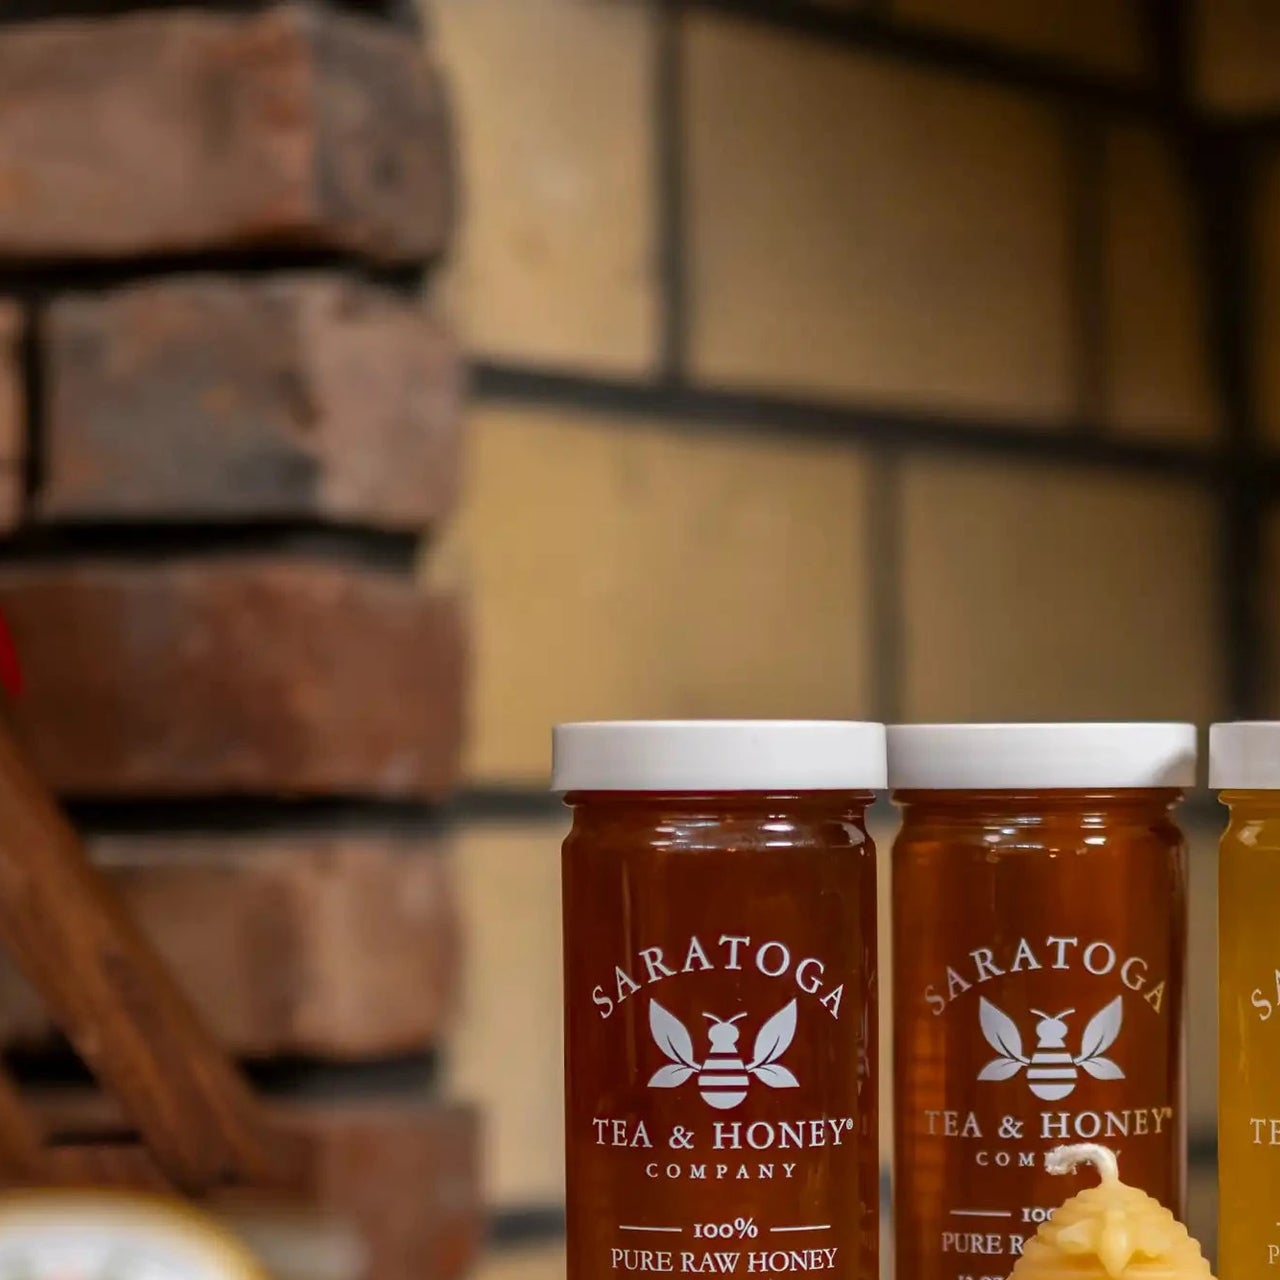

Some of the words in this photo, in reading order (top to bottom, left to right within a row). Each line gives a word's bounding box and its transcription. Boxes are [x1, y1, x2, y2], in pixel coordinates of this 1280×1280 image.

[591, 935, 844, 1020] SARATOGA
[924, 936, 1166, 1017] SARATOGA
[593, 1118, 653, 1148] TEA
[669, 1126, 694, 1149] &
[925, 1110, 982, 1138] TEA
[999, 1116, 1023, 1138] &
[646, 1163, 796, 1179] COMPANY
[694, 1218, 758, 1238] 100%
[943, 1234, 1003, 1254] PURE
[611, 1248, 673, 1271] PURE
[681, 1252, 740, 1273] RAW
[748, 1248, 837, 1272] HONEY
